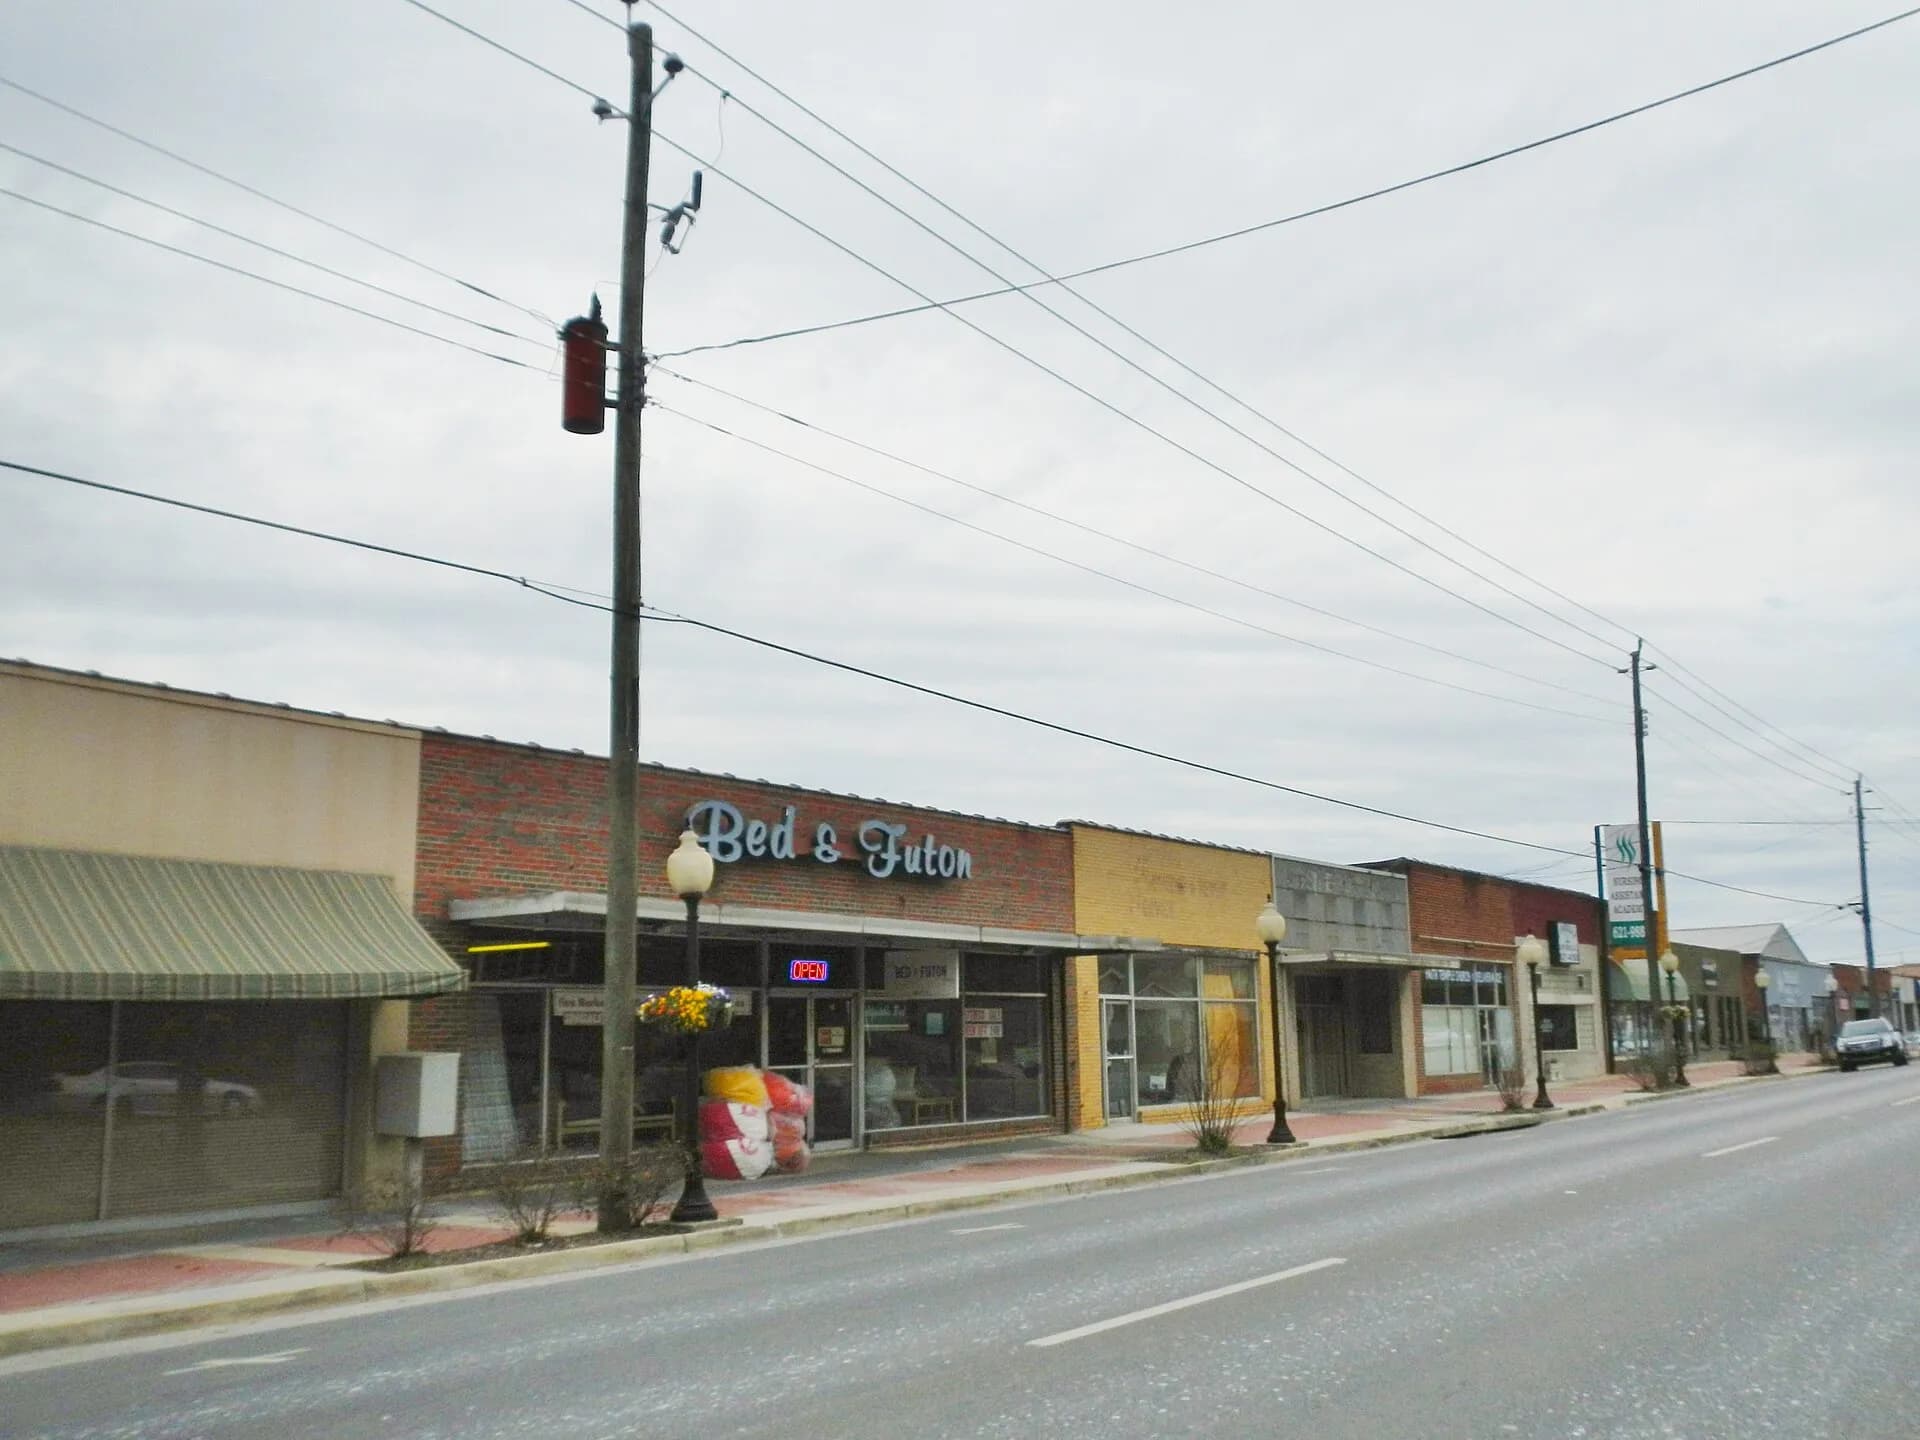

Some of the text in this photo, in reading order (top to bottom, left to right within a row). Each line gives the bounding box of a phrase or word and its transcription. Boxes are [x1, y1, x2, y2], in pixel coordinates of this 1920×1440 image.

[688, 799, 972, 879] Bed & Futon
[793, 960, 825, 979] OPEN
